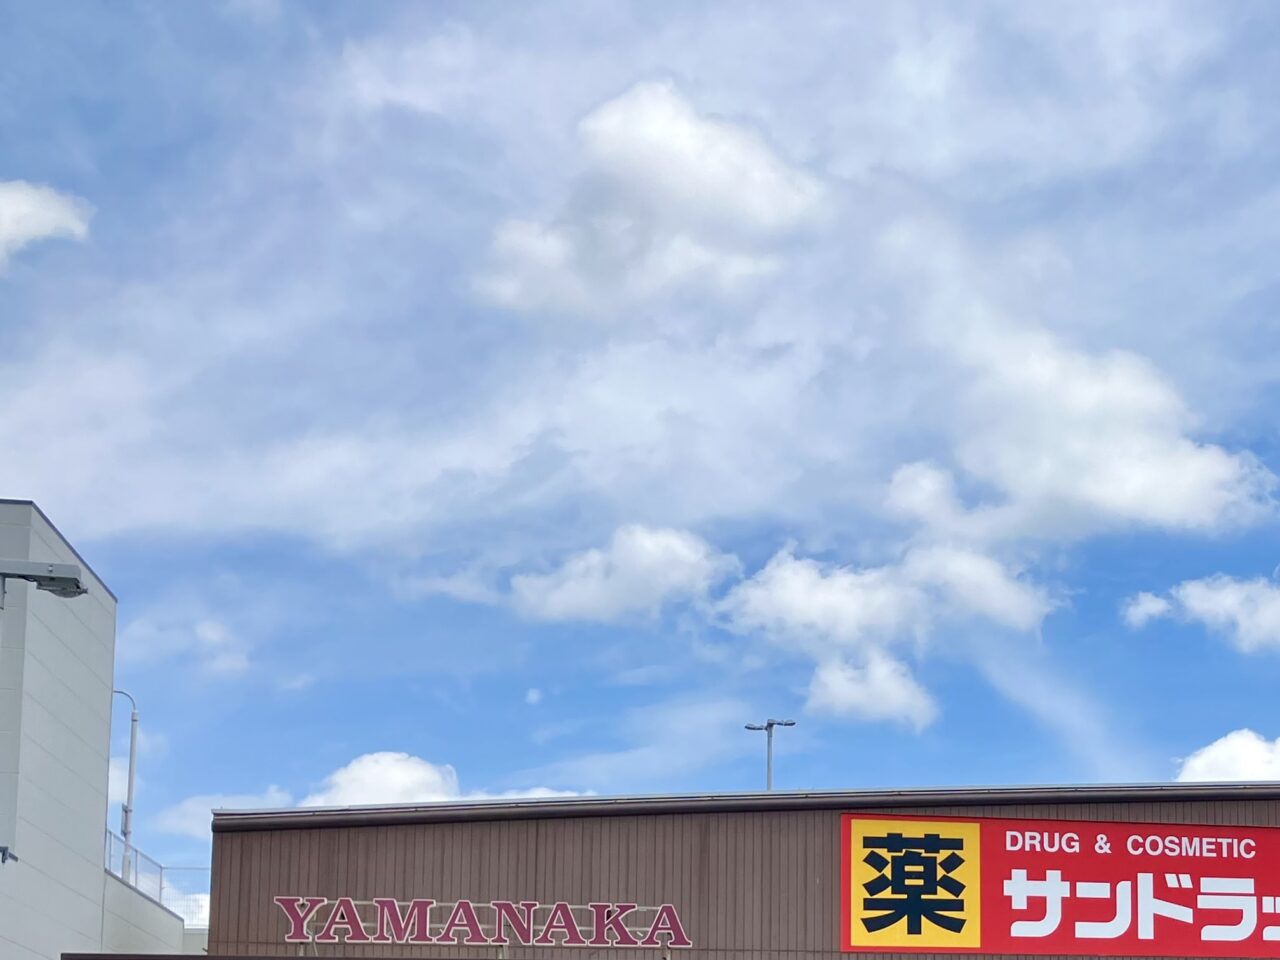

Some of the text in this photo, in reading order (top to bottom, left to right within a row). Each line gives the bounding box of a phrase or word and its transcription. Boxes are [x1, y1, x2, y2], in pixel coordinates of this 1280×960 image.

[1005, 830, 1257, 859] DRUG & COSMETIC
[861, 832, 967, 935] 薬
[274, 895, 693, 948] YAMANAKA
